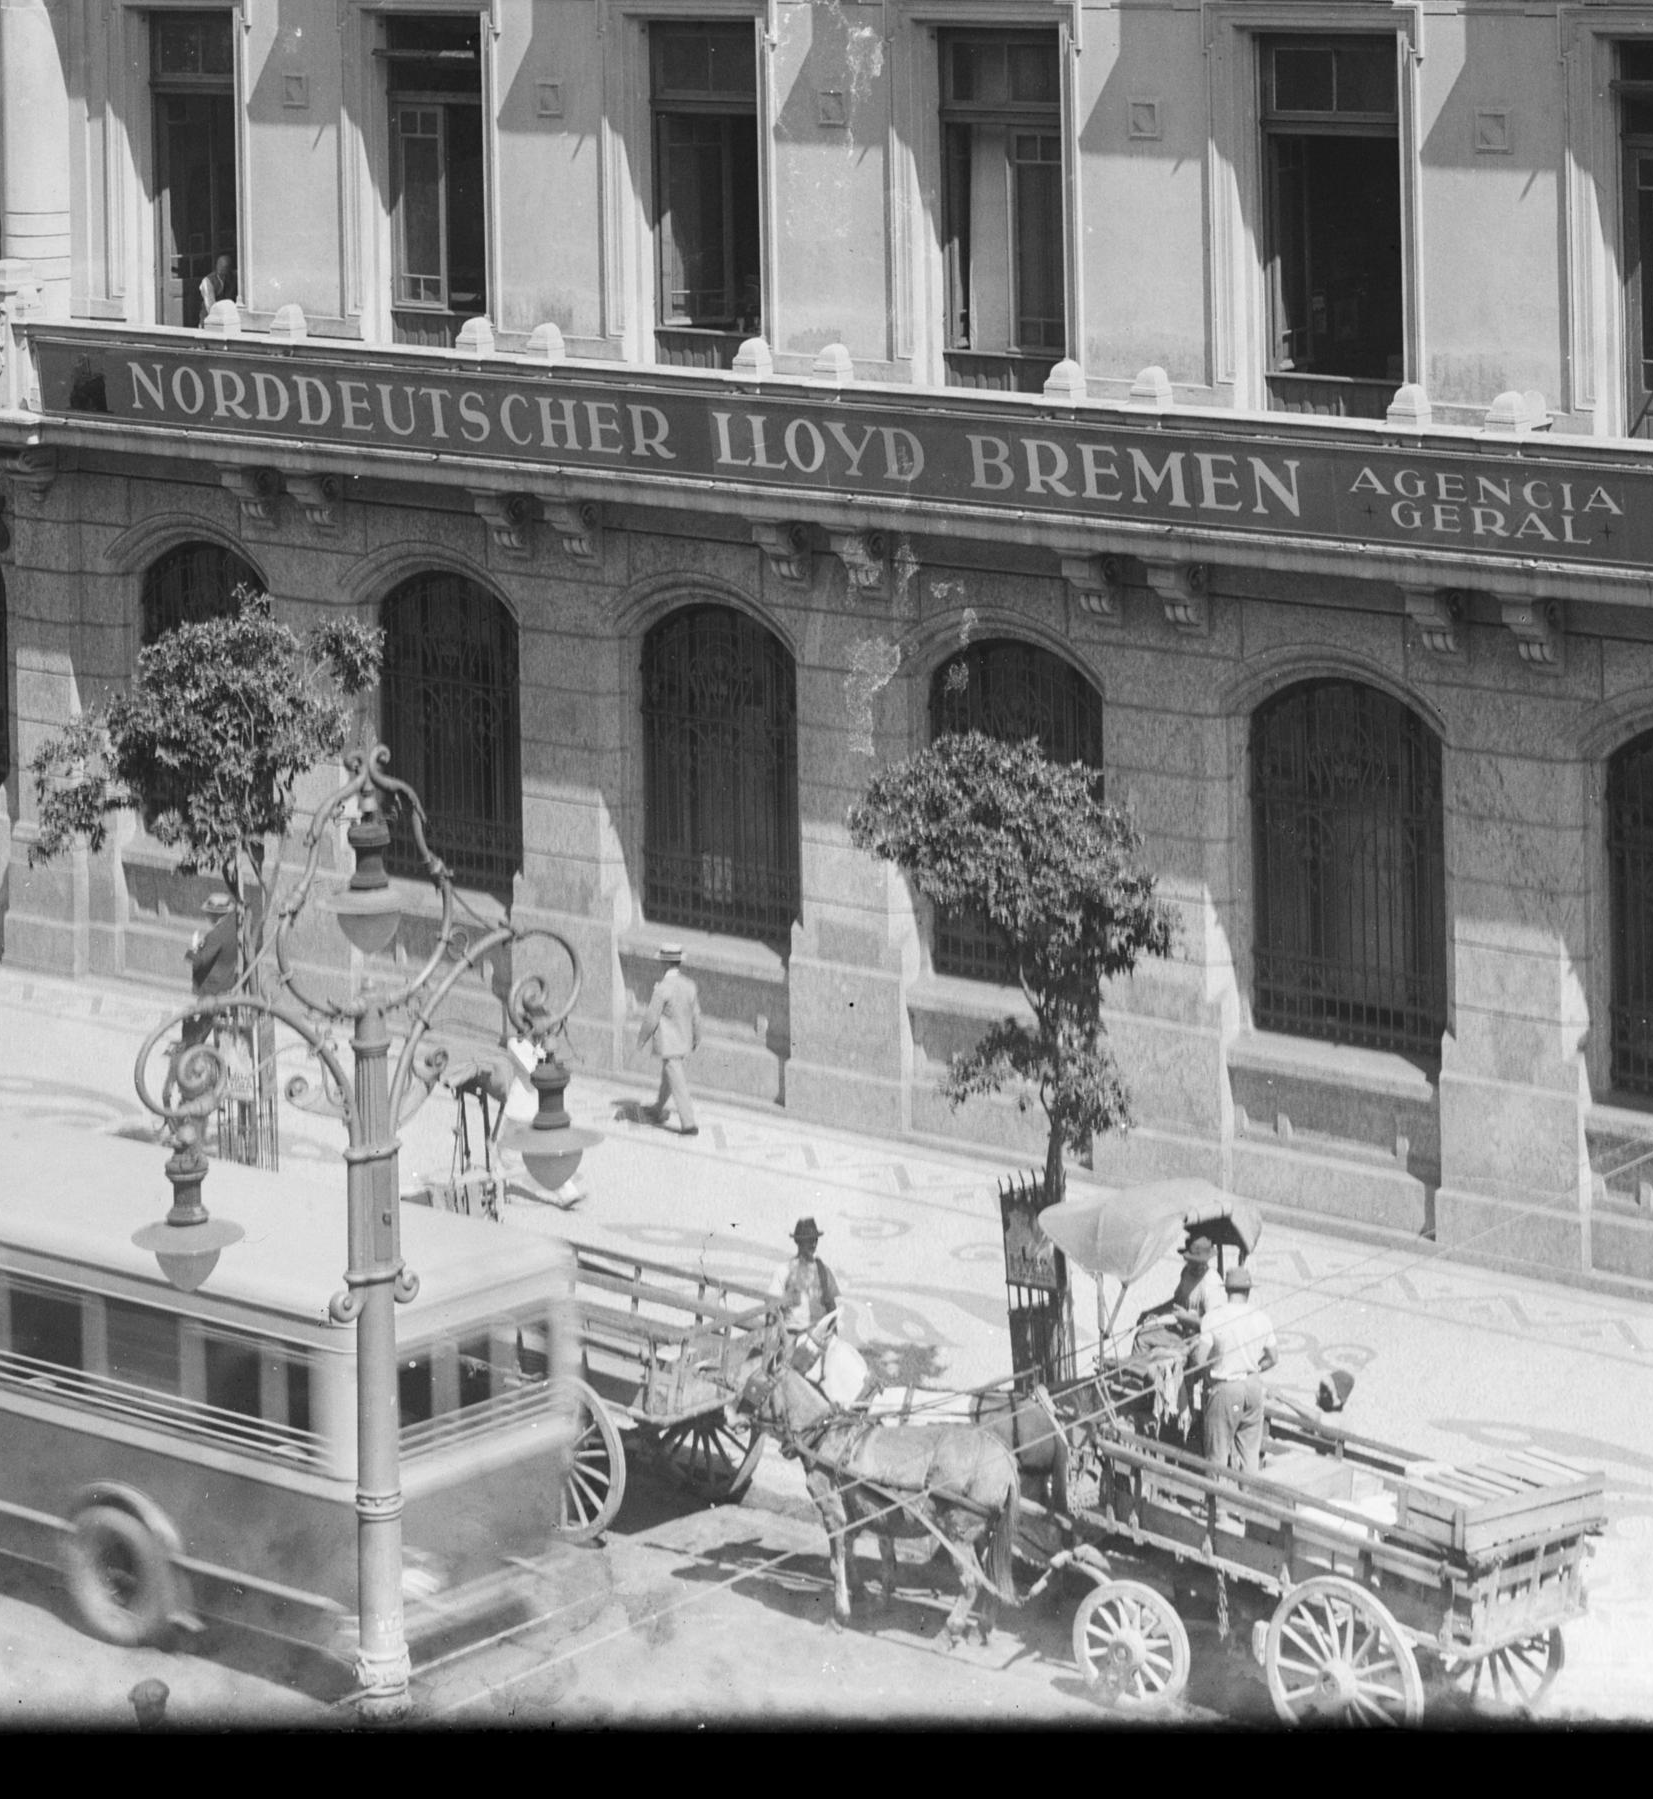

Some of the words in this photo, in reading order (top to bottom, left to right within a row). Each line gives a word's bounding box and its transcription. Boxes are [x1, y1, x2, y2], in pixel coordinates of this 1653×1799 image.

[127, 360, 677, 460] NORDDEUTSCHER
[711, 411, 925, 481] LLOYD
[965, 433, 1301, 518] BREMEN
[1349, 466, 1624, 516] AGENCIA
[1390, 500, 1592, 545] GERAL
